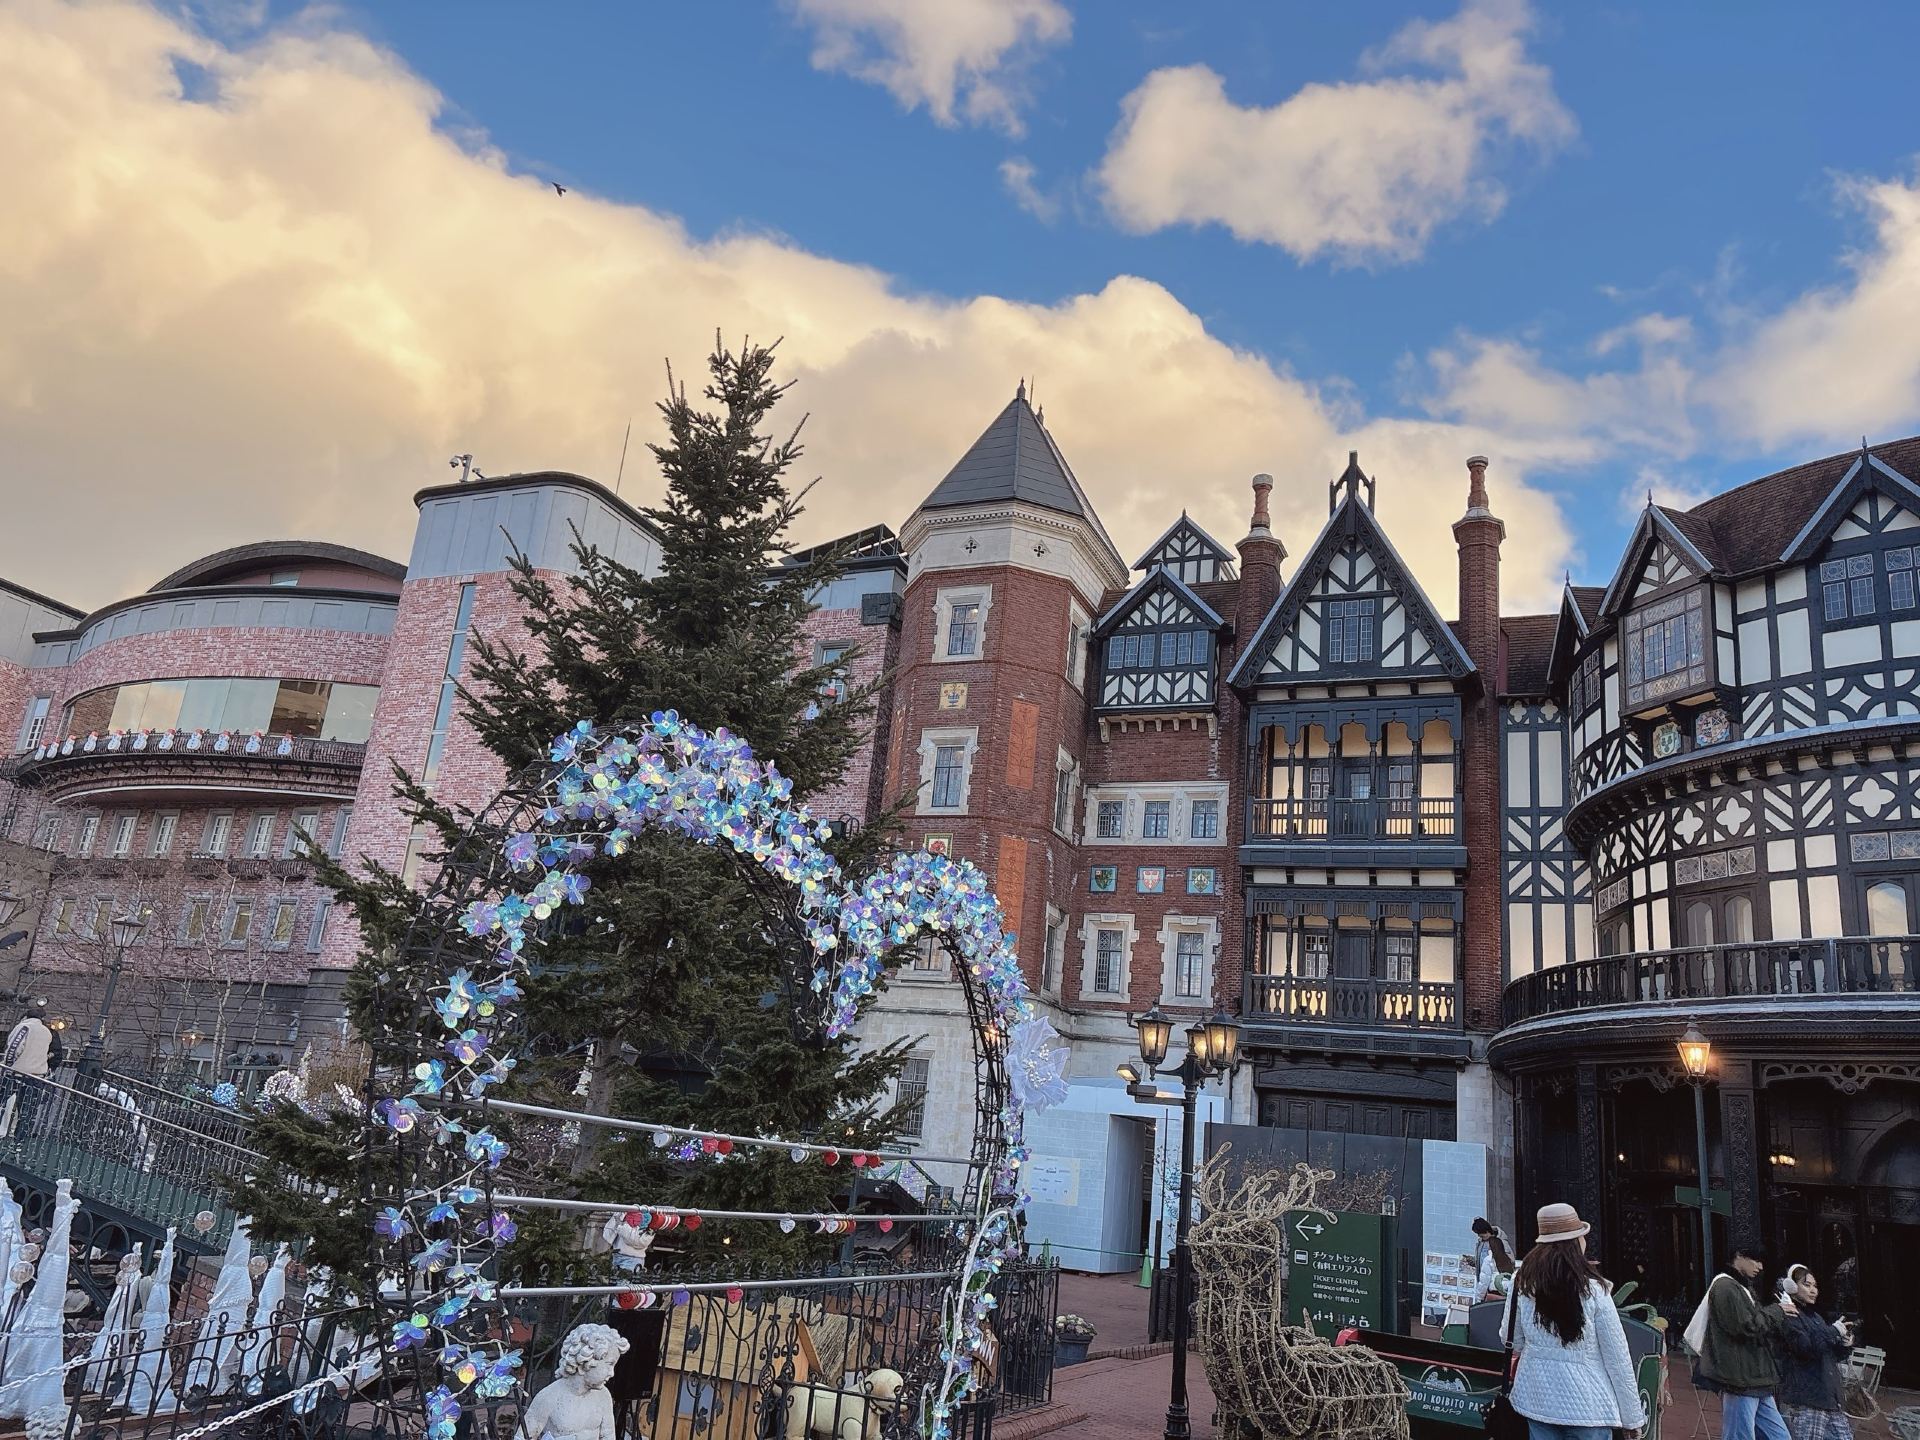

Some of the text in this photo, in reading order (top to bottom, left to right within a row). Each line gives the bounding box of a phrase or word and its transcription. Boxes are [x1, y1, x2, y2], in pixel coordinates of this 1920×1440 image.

[1312, 1251, 1373, 1264] チケットセンター
[1313, 1275, 1359, 1286] TICKET CENTER
[1312, 1283, 1335, 1291] Entrance
[1342, 1286, 1354, 1294] Paid
[1430, 1394, 1464, 1409] KOIBITO
